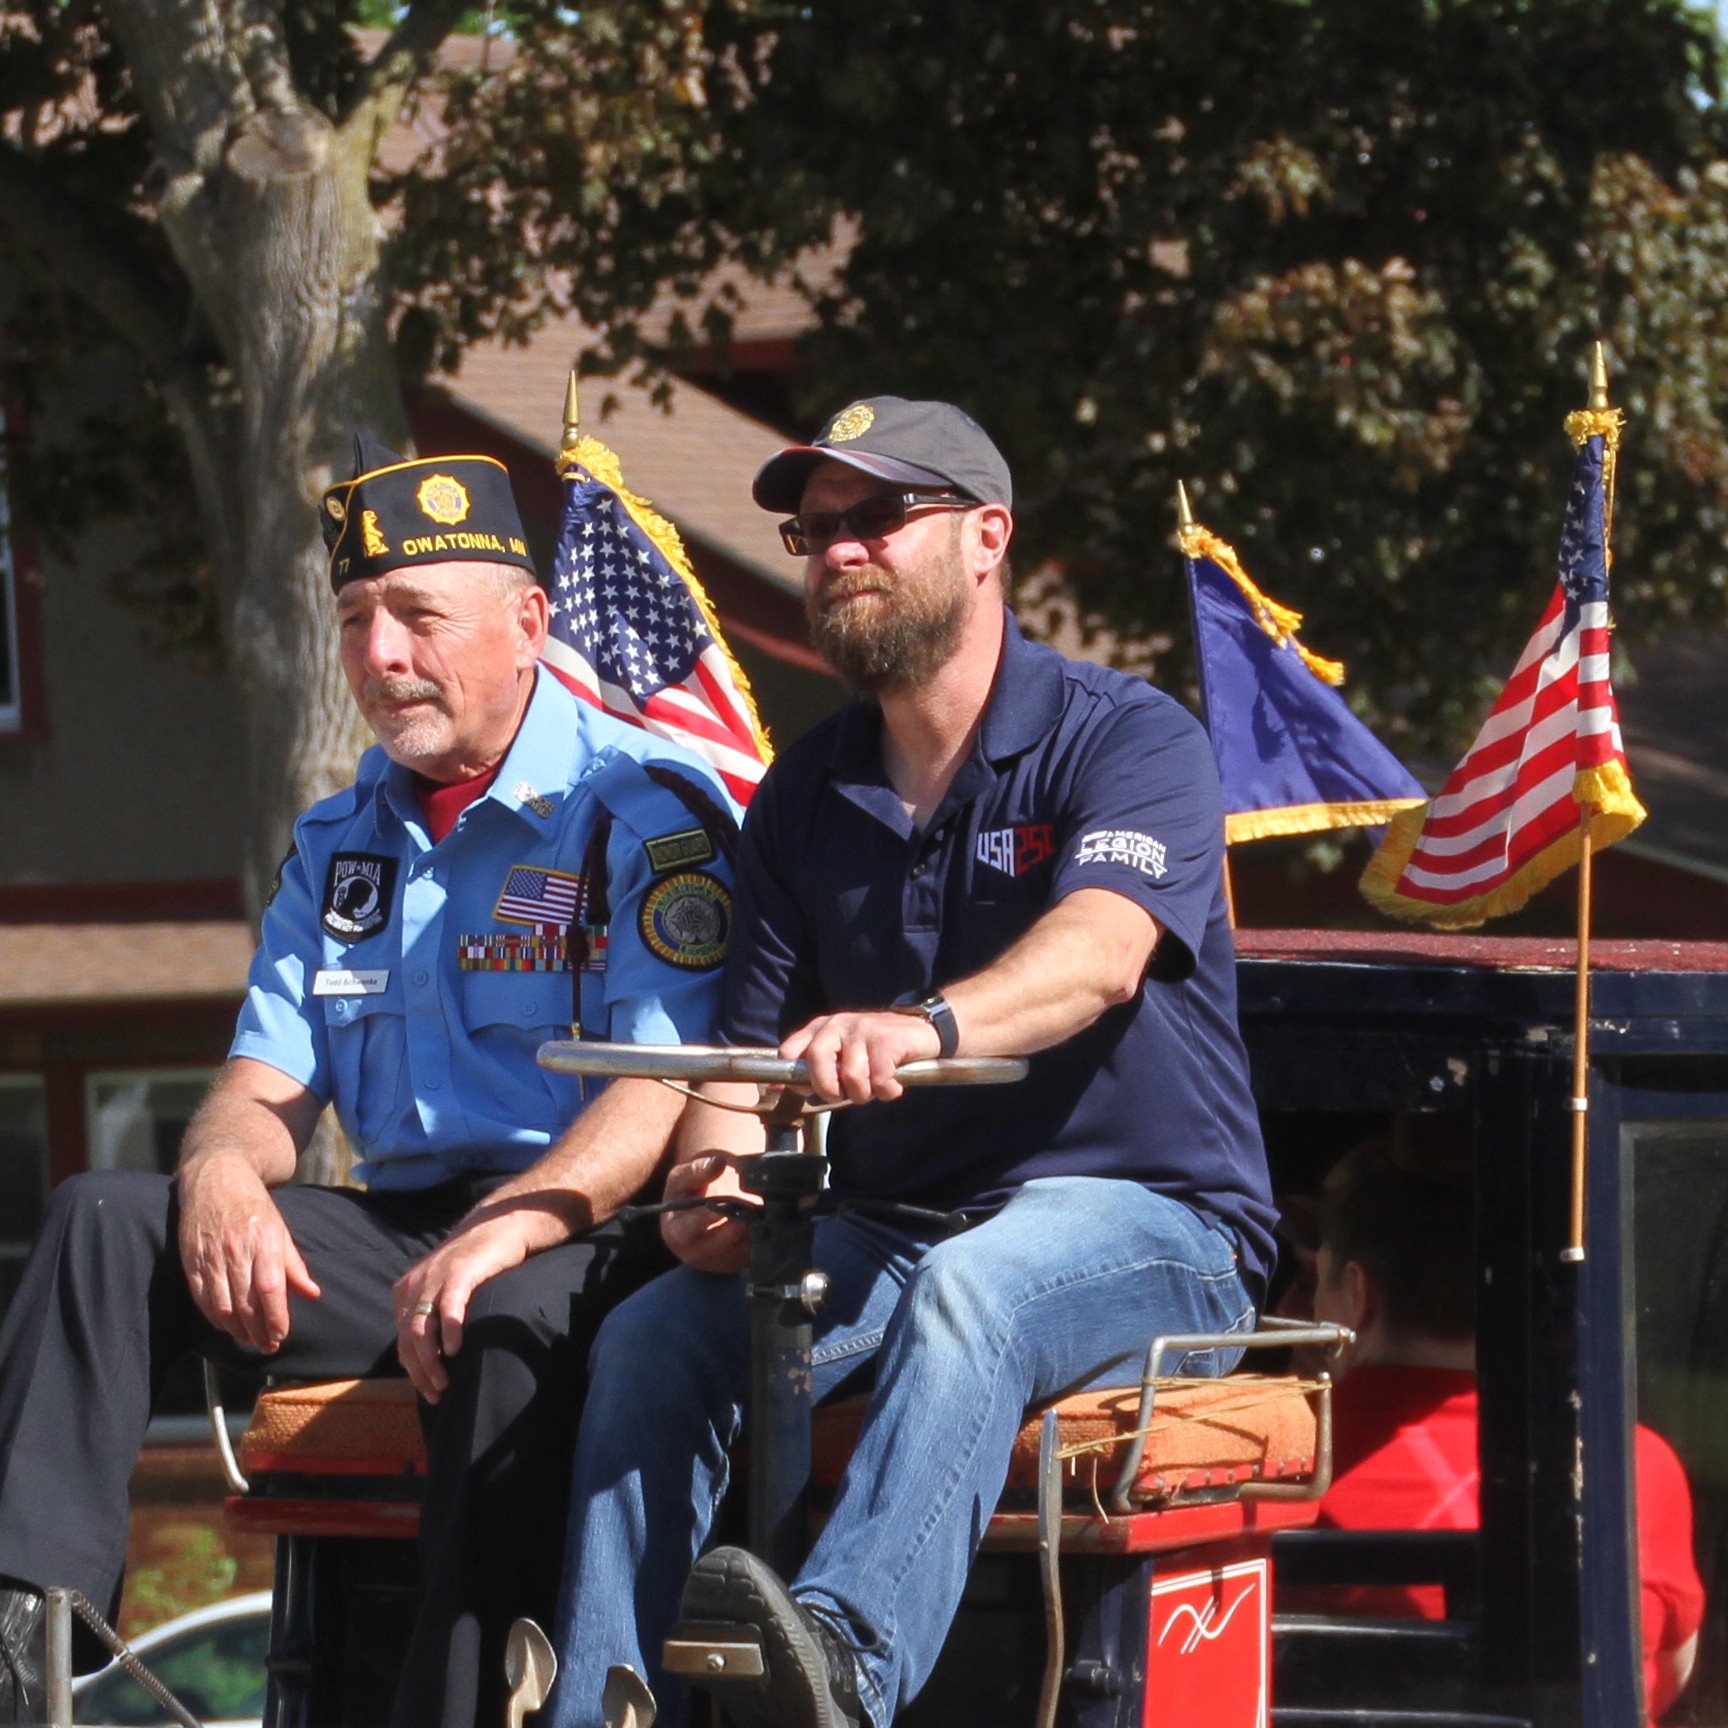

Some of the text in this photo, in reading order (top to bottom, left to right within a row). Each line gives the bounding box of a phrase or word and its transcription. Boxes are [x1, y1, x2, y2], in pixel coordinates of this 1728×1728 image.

[402, 532, 506, 556] OWATONNA,
[338, 557, 351, 576] 77
[1081, 836, 1165, 866] LEGION
[1107, 829, 1167, 853] AMERICAN
[1079, 851, 1166, 879] FAMILY
